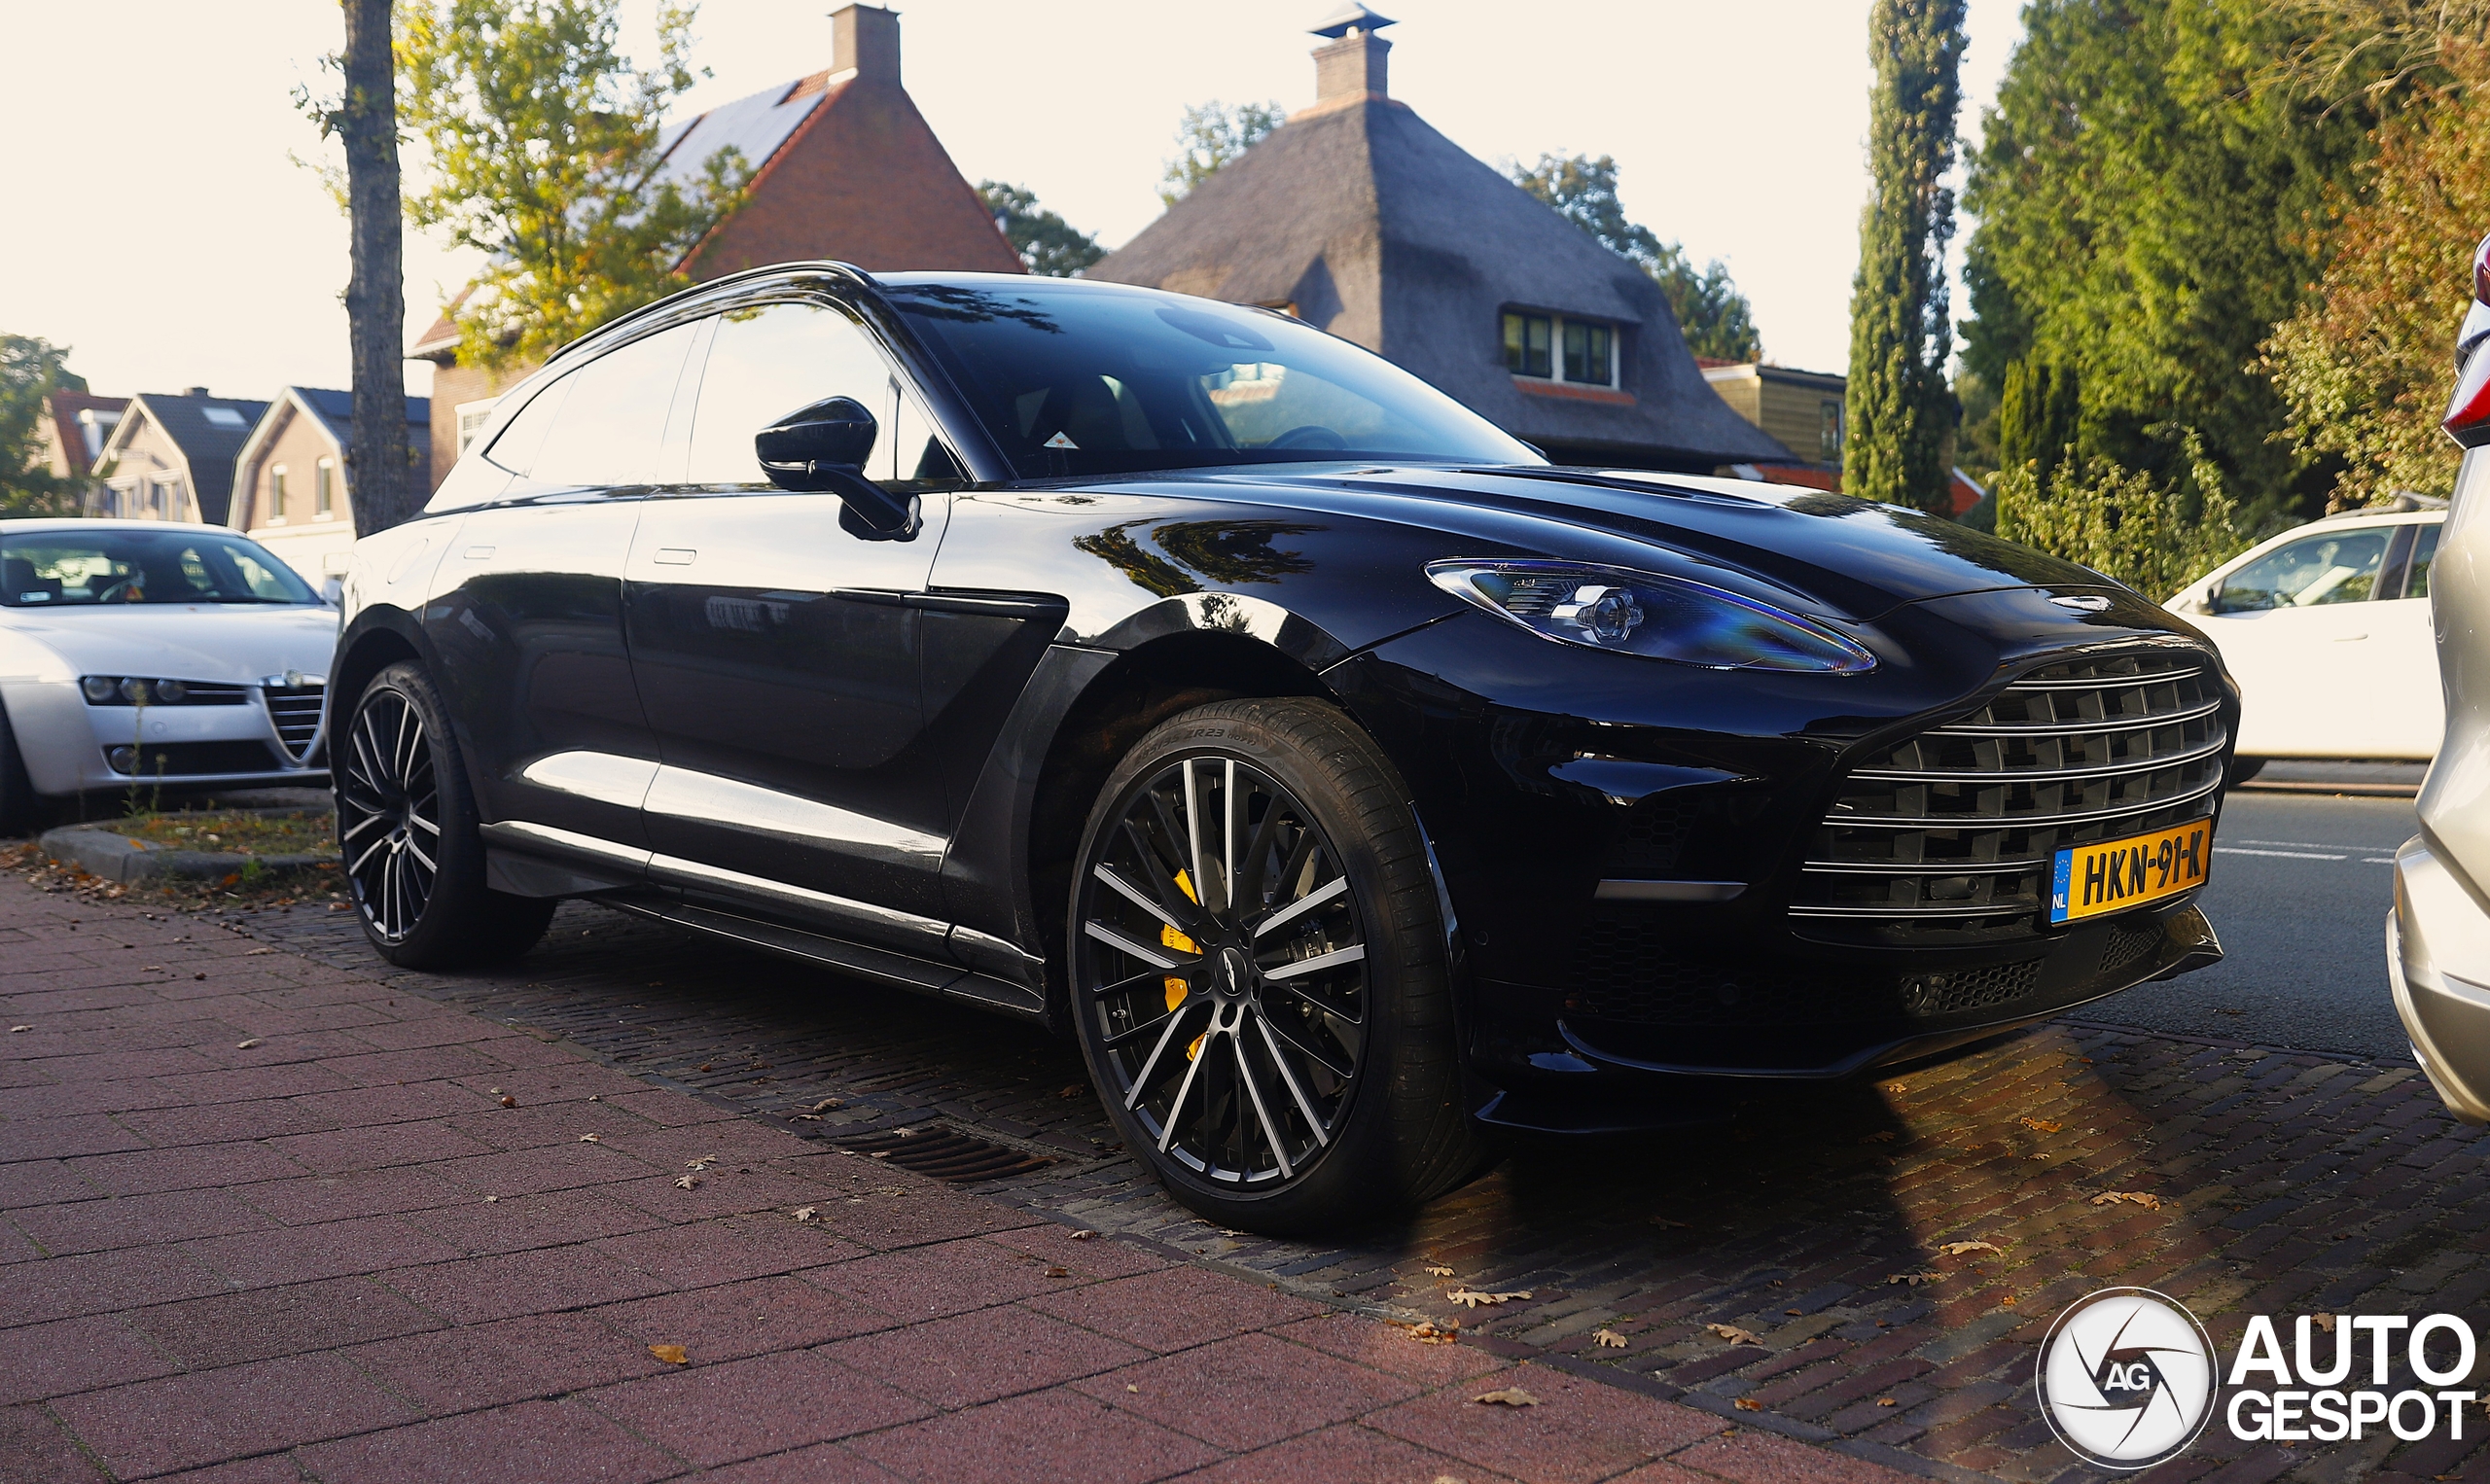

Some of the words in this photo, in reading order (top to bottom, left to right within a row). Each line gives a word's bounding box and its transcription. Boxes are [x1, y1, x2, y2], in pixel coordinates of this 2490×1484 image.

[1183, 728, 1226, 740] ZR23
[2083, 830, 2203, 906] HKN-91-K
[2052, 893, 2066, 909] NL
